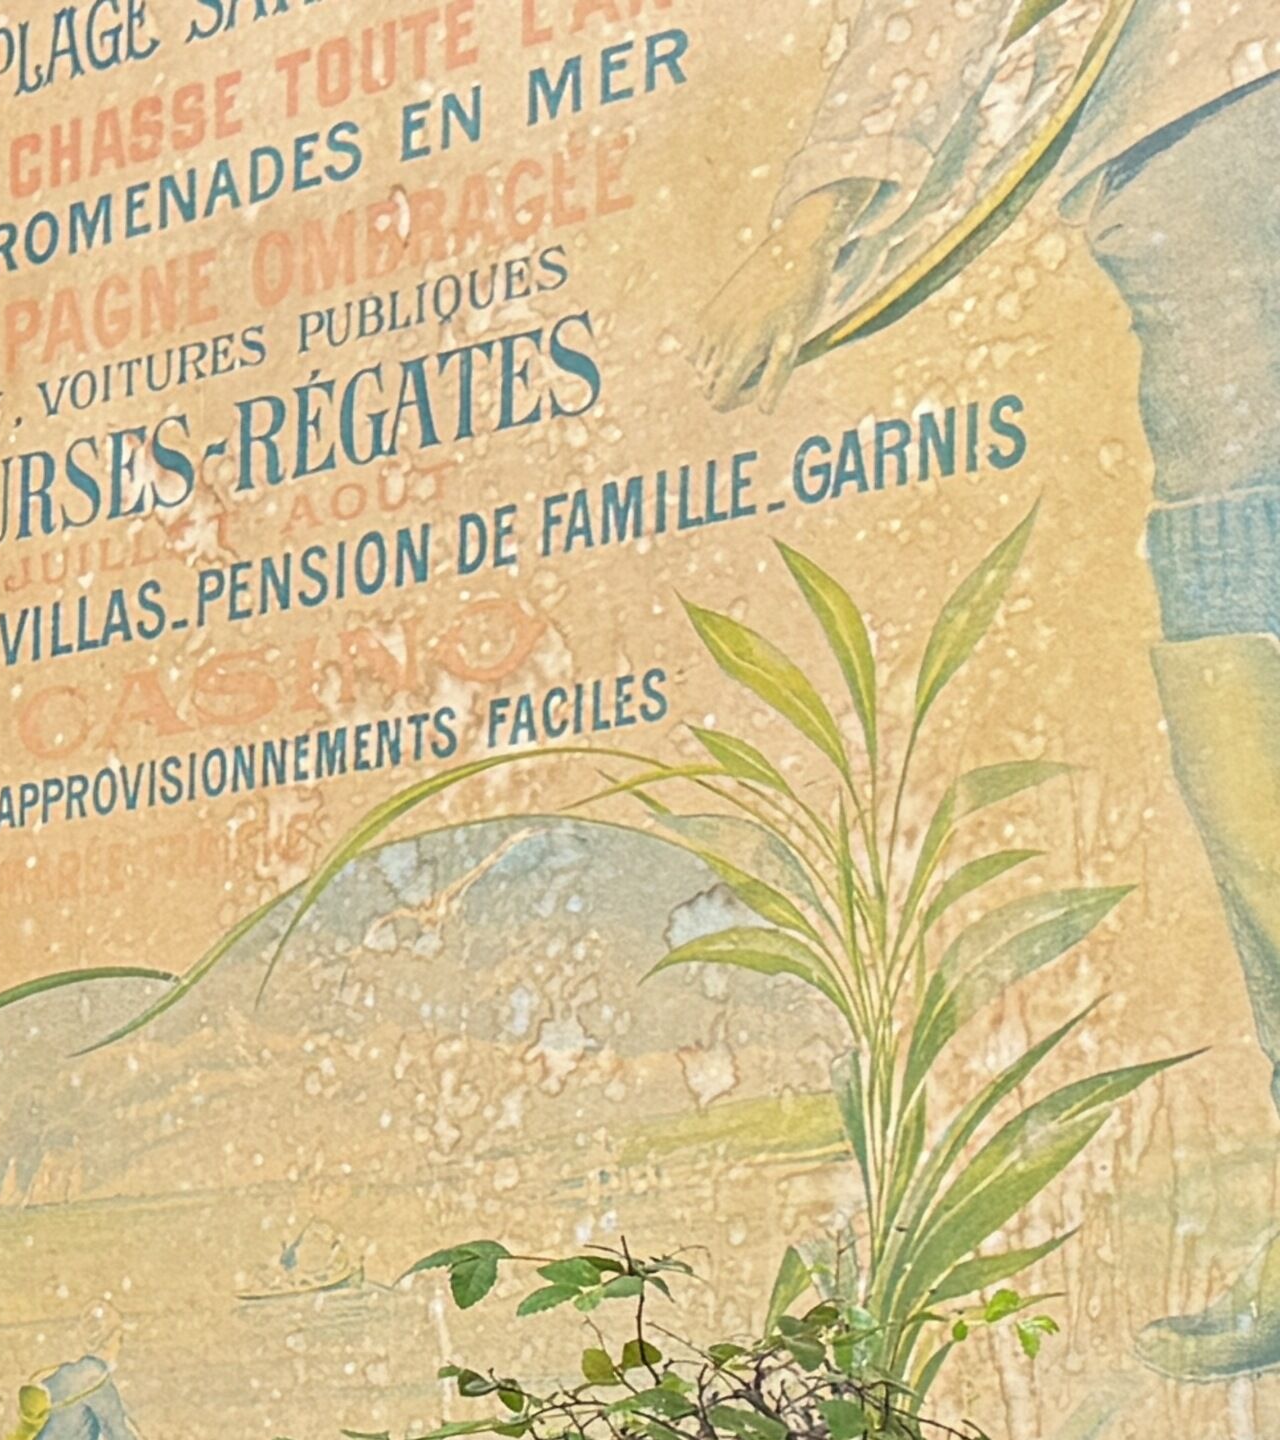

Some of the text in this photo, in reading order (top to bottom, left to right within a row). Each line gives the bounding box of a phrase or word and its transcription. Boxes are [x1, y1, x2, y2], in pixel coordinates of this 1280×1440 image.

[8, 70, 243, 198] CHASSE
[275, 0, 478, 118] TOUTE
[400, 85, 482, 162] EN
[527, 29, 689, 127] MER
[251, 131, 636, 310] OMBRAGÉE
[37, 325, 265, 417] VOITURES
[297, 245, 569, 354] PUBLIQUES
[456, 504, 517, 575] DE
[17, 598, 547, 759] CASINO
[486, 667, 669, 748] FACILES
